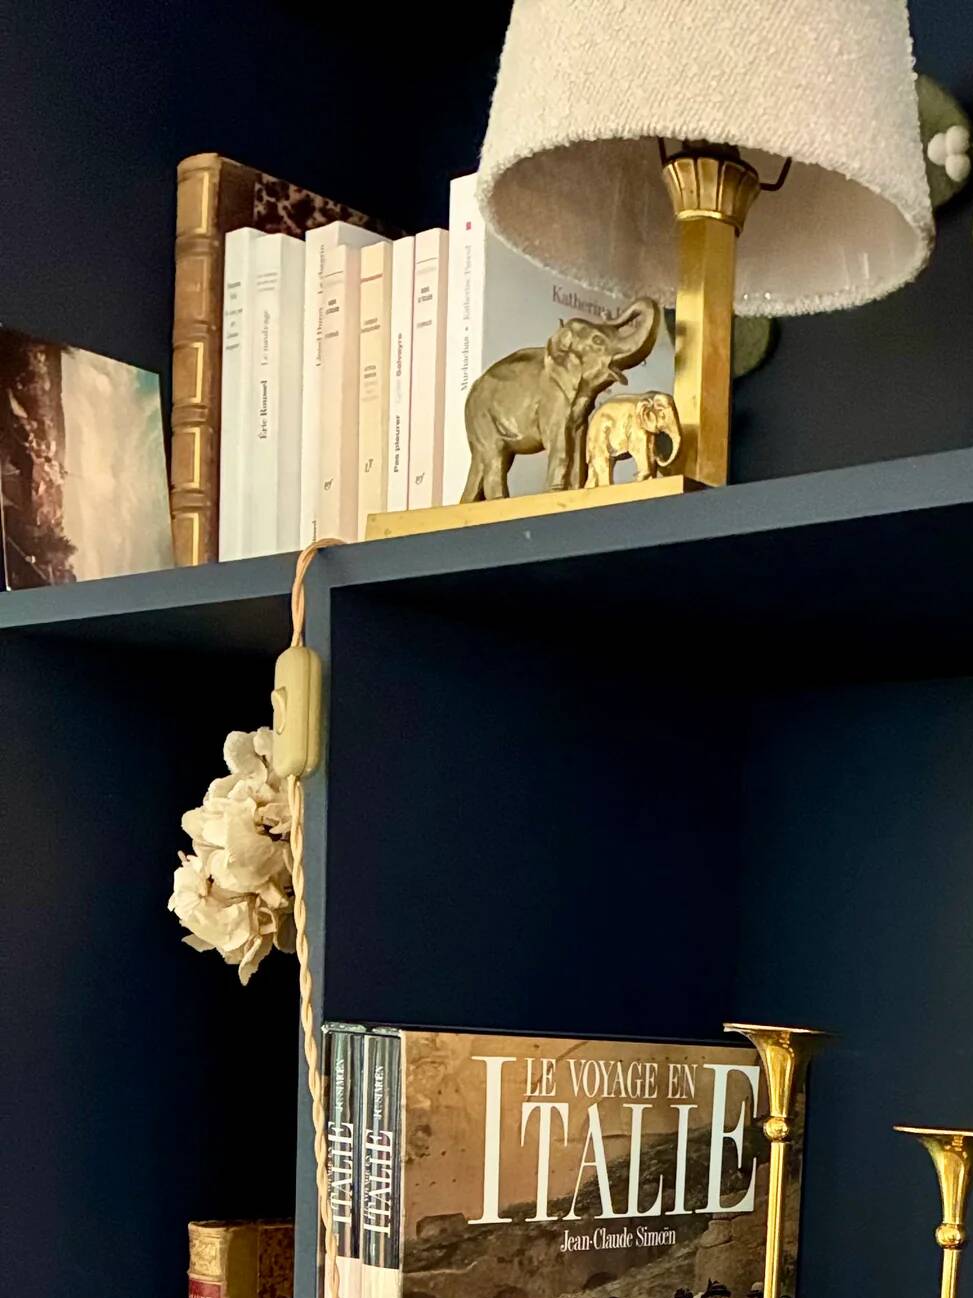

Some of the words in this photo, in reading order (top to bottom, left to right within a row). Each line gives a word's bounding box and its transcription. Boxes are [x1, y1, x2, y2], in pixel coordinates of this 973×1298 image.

[523, 1057, 556, 1097] LE
[566, 1058, 658, 1099] VOYAGE
[667, 1063, 698, 1099] EN
[328, 1121, 353, 1227] ITALIE
[364, 1129, 393, 1238] ITALIE
[467, 1056, 761, 1225] ITALIE
